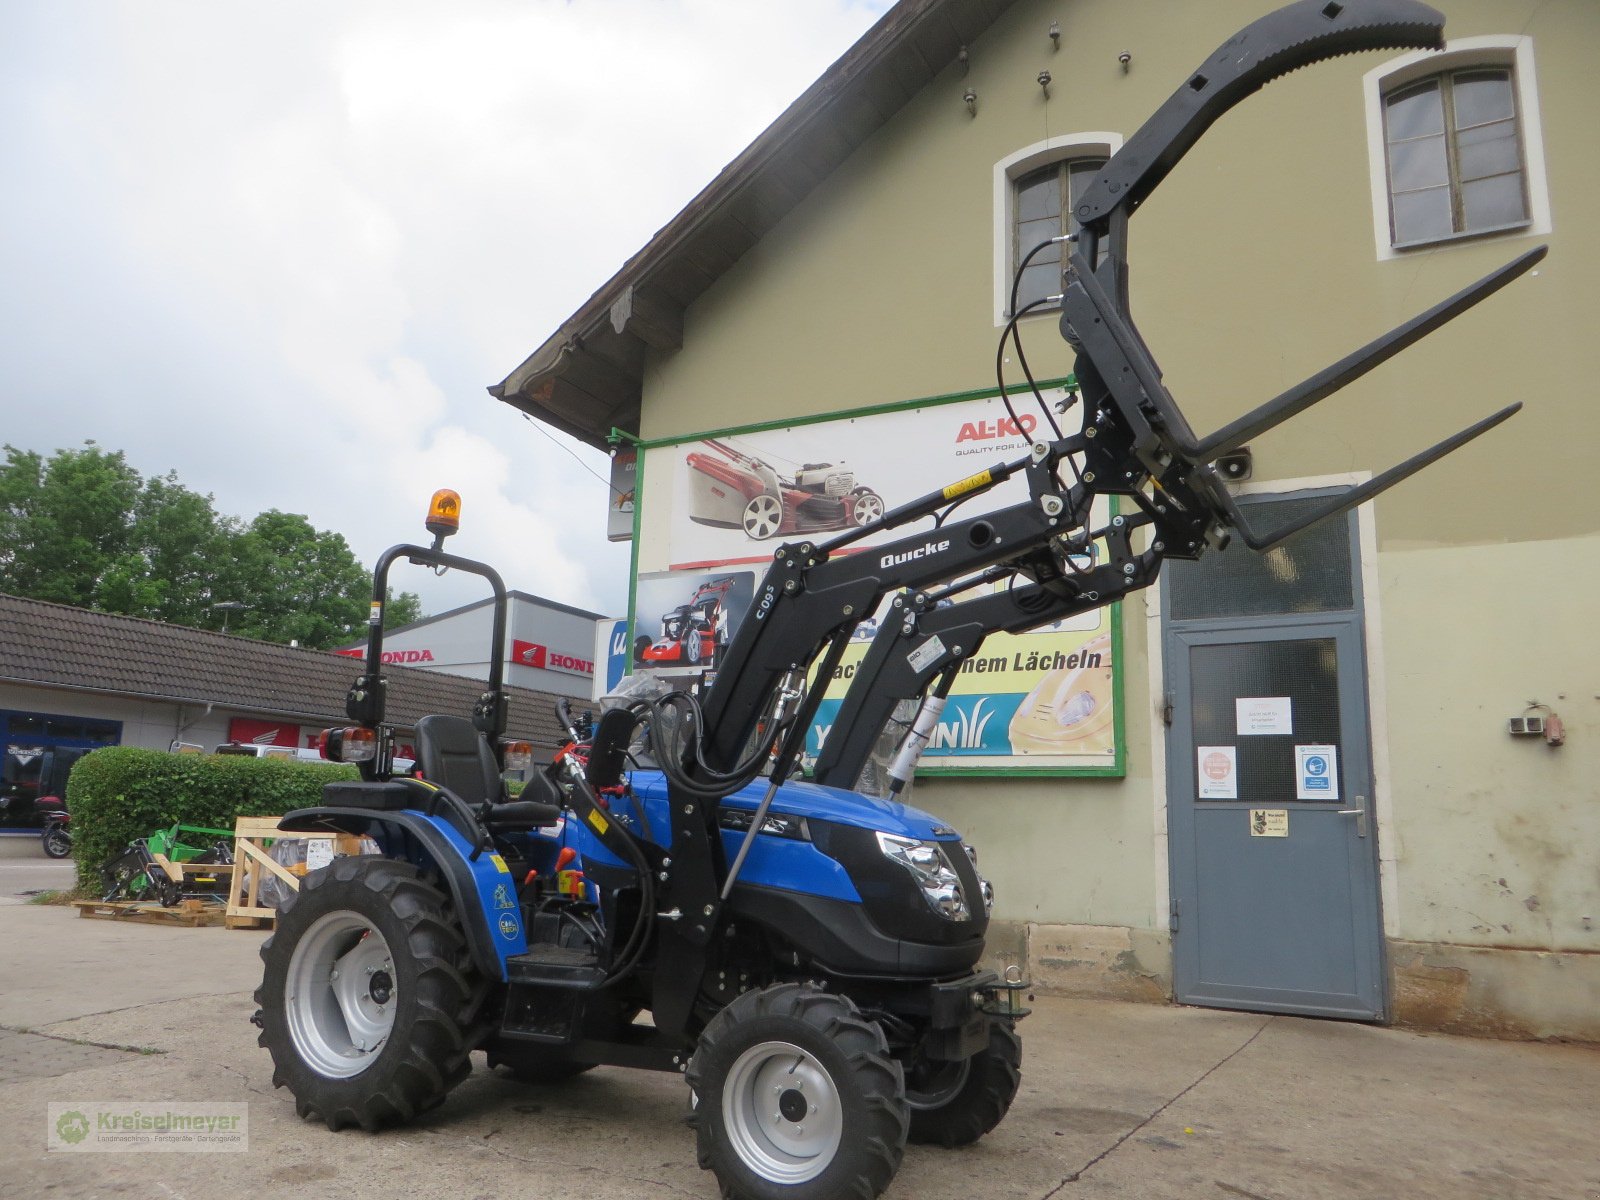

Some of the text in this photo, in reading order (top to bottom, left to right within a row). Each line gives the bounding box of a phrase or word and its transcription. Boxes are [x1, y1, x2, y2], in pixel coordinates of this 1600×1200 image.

[955, 414, 1037, 443] AL-KO
[955, 446, 994, 457] QUALITY
[880, 540, 950, 569] Quicke
[381, 650, 434, 663] ONDA
[550, 653, 594, 674] HOND
[961, 656, 1008, 673] nem
[1013, 650, 1102, 671] Lächeln
